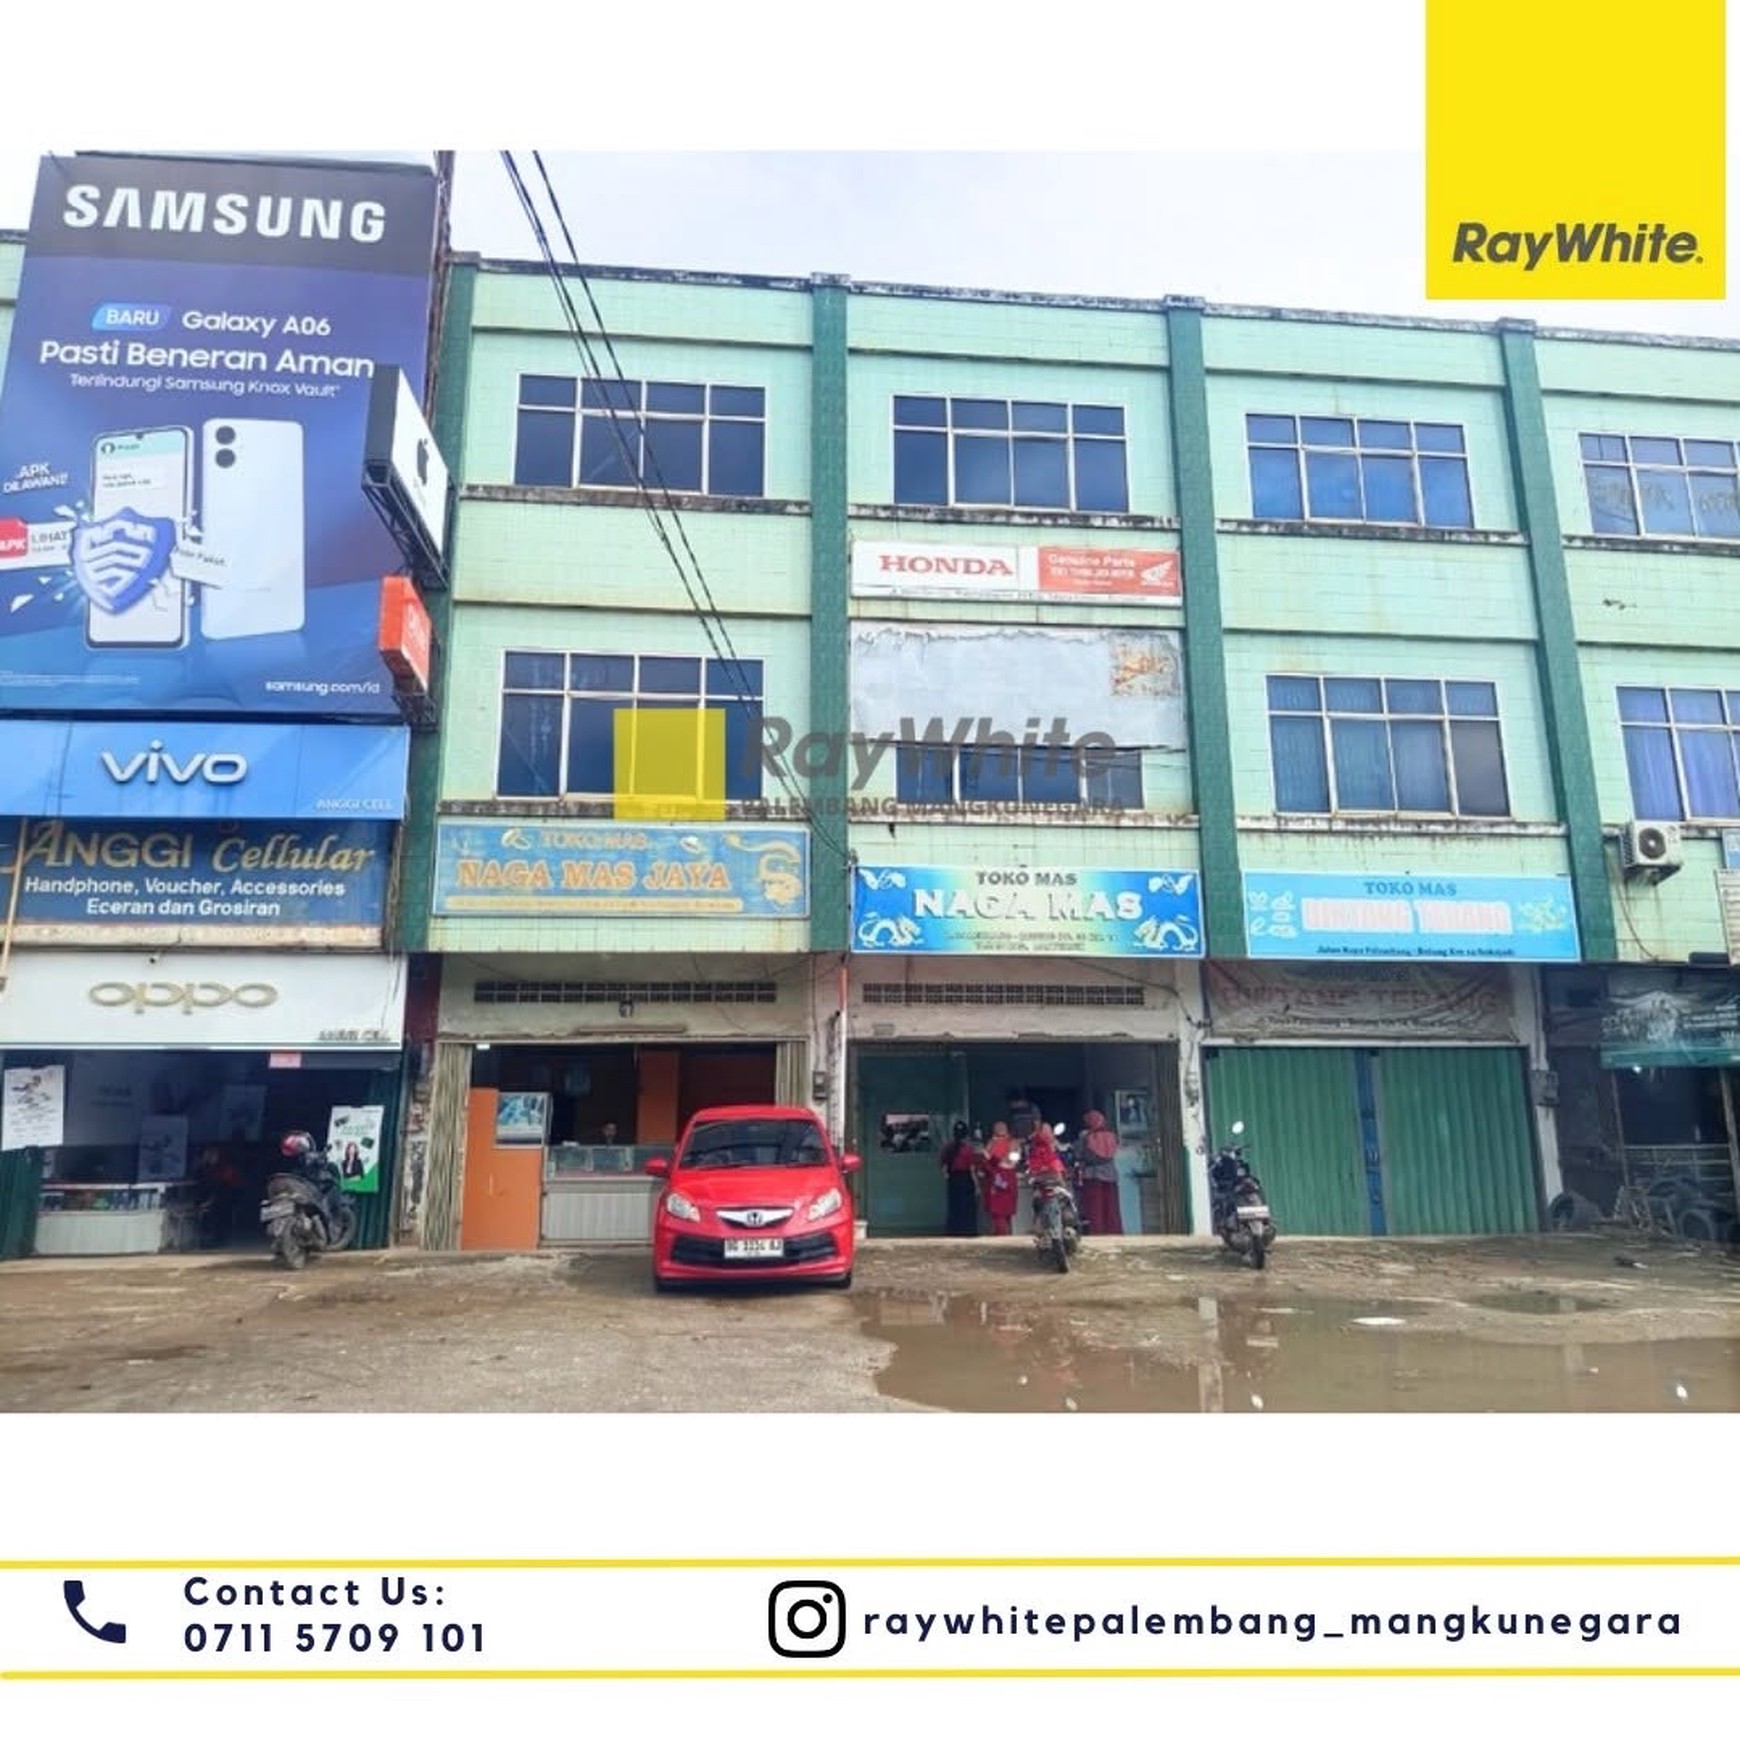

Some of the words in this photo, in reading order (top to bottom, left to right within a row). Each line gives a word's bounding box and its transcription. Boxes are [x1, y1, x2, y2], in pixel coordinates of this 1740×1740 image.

[63, 184, 386, 243] SAMSUNG
[106, 308, 160, 327] BARU
[182, 310, 276, 338] Galaxy
[281, 315, 332, 337] A06
[39, 339, 119, 365] Pasti
[127, 342, 268, 373] Beneran
[275, 349, 375, 379] Aman
[70, 373, 162, 392] Terlindungi
[164, 375, 245, 396] Samsung
[248, 381, 291, 395] Knox
[880, 554, 1013, 576] HONDA
[265, 681, 380, 696] samsung.com/id
[102, 739, 249, 784] vivo
[24, 820, 191, 868] ANGGI
[212, 834, 376, 873] Cellular
[25, 877, 140, 897] Handphone,
[145, 878, 227, 898] Voucher,
[231, 879, 347, 898] Accessories
[457, 859, 552, 889] NAGA
[561, 861, 637, 889] MAS
[645, 861, 732, 891] JAYA
[977, 871, 1030, 886] TOKO
[1034, 872, 1078, 887] MAS
[1364, 880, 1415, 896] TOKO
[1418, 881, 1458, 897] MAS
[87, 898, 154, 916] Eceran
[158, 898, 196, 916] dan
[199, 899, 281, 918] Grosiran
[912, 888, 1036, 921] NAGA
[1048, 890, 1144, 922] MAS
[89, 982, 278, 1015] oppo
